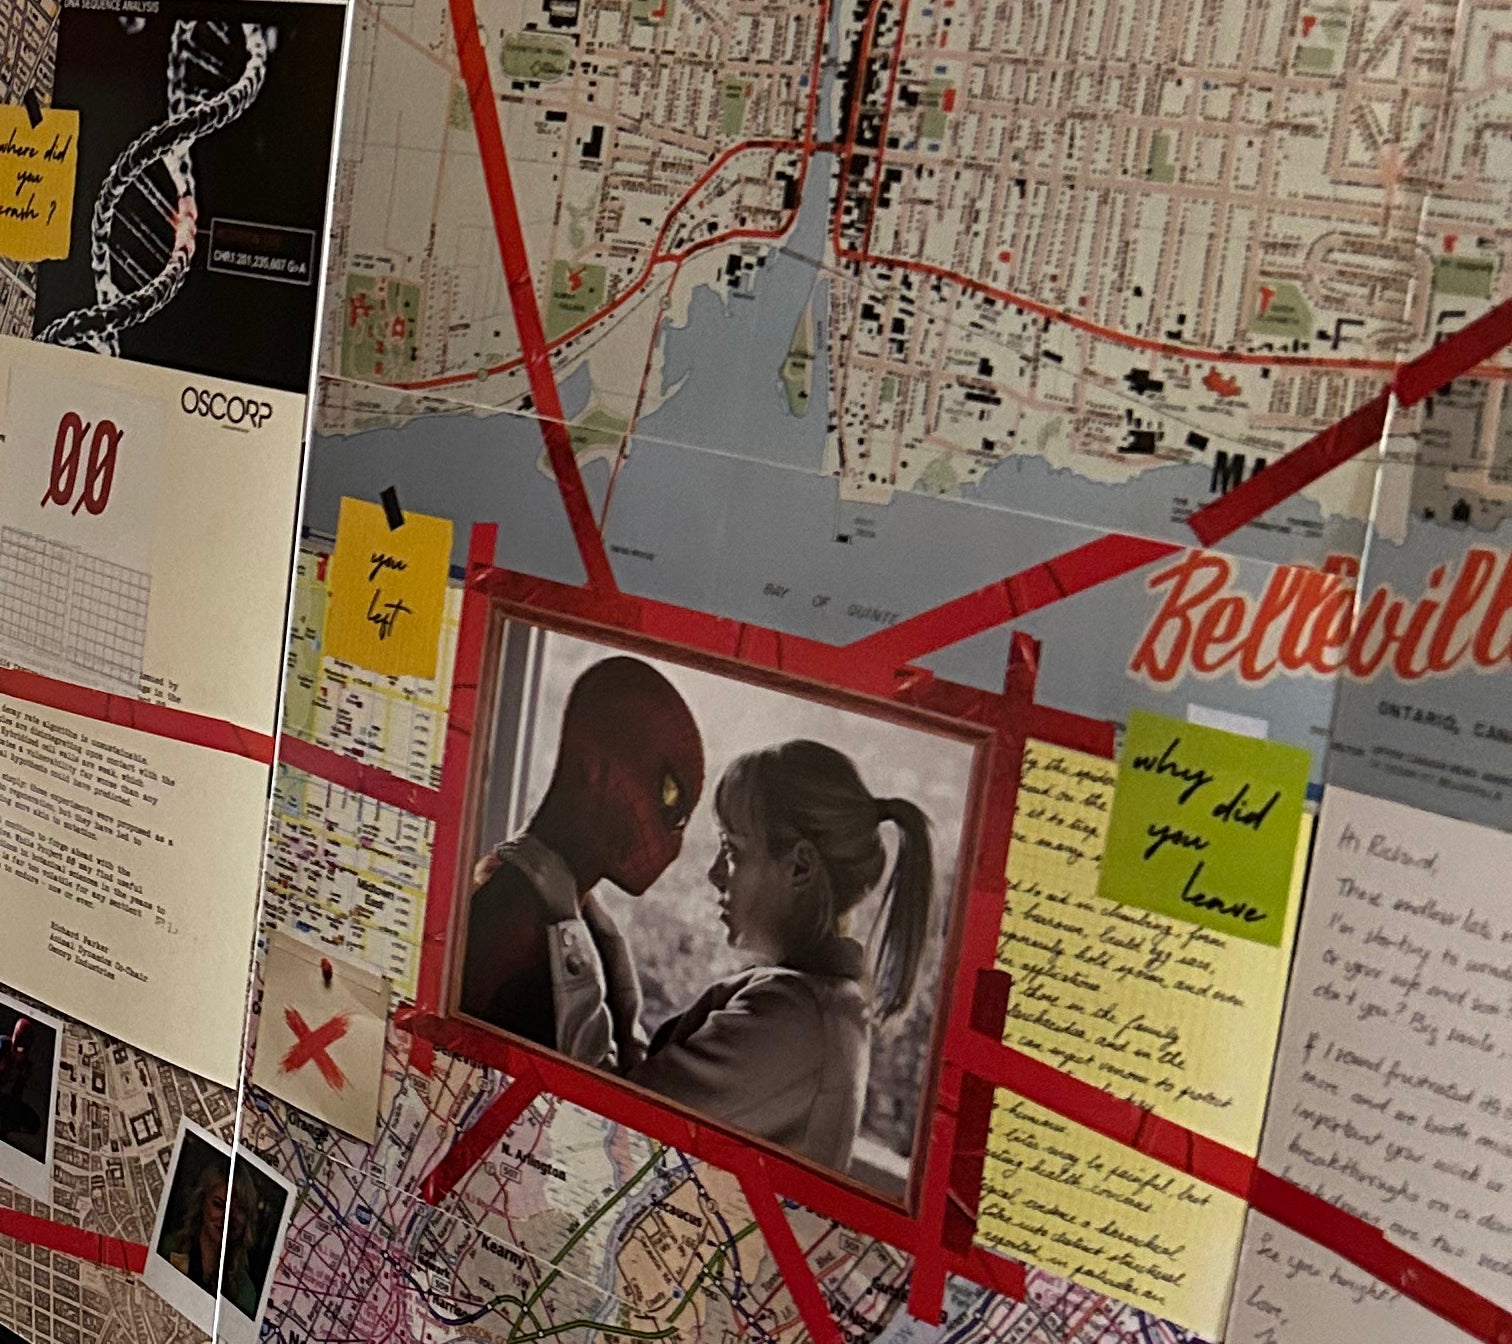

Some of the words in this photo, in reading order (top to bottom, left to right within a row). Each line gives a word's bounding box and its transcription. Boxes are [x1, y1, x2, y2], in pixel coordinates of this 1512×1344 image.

[122, 1, 159, 14] ANALYSIS
[44, 134, 72, 163] did
[16, 171, 43, 196] you
[181, 386, 273, 429] OSCORP
[370, 551, 407, 582] you
[366, 588, 412, 639] left
[1130, 549, 1512, 681] Bellevill
[1379, 701, 1460, 735] ONTARIO,
[1473, 721, 1511, 743] CAN
[1133, 738, 1213, 804] why
[1212, 791, 1281, 830] did
[1145, 824, 1209, 859] you
[1181, 861, 1266, 922] leave
[288, 1113, 329, 1142] Orange
[517, 1150, 567, 1181] Arlington
[480, 1233, 527, 1271] Kearny
